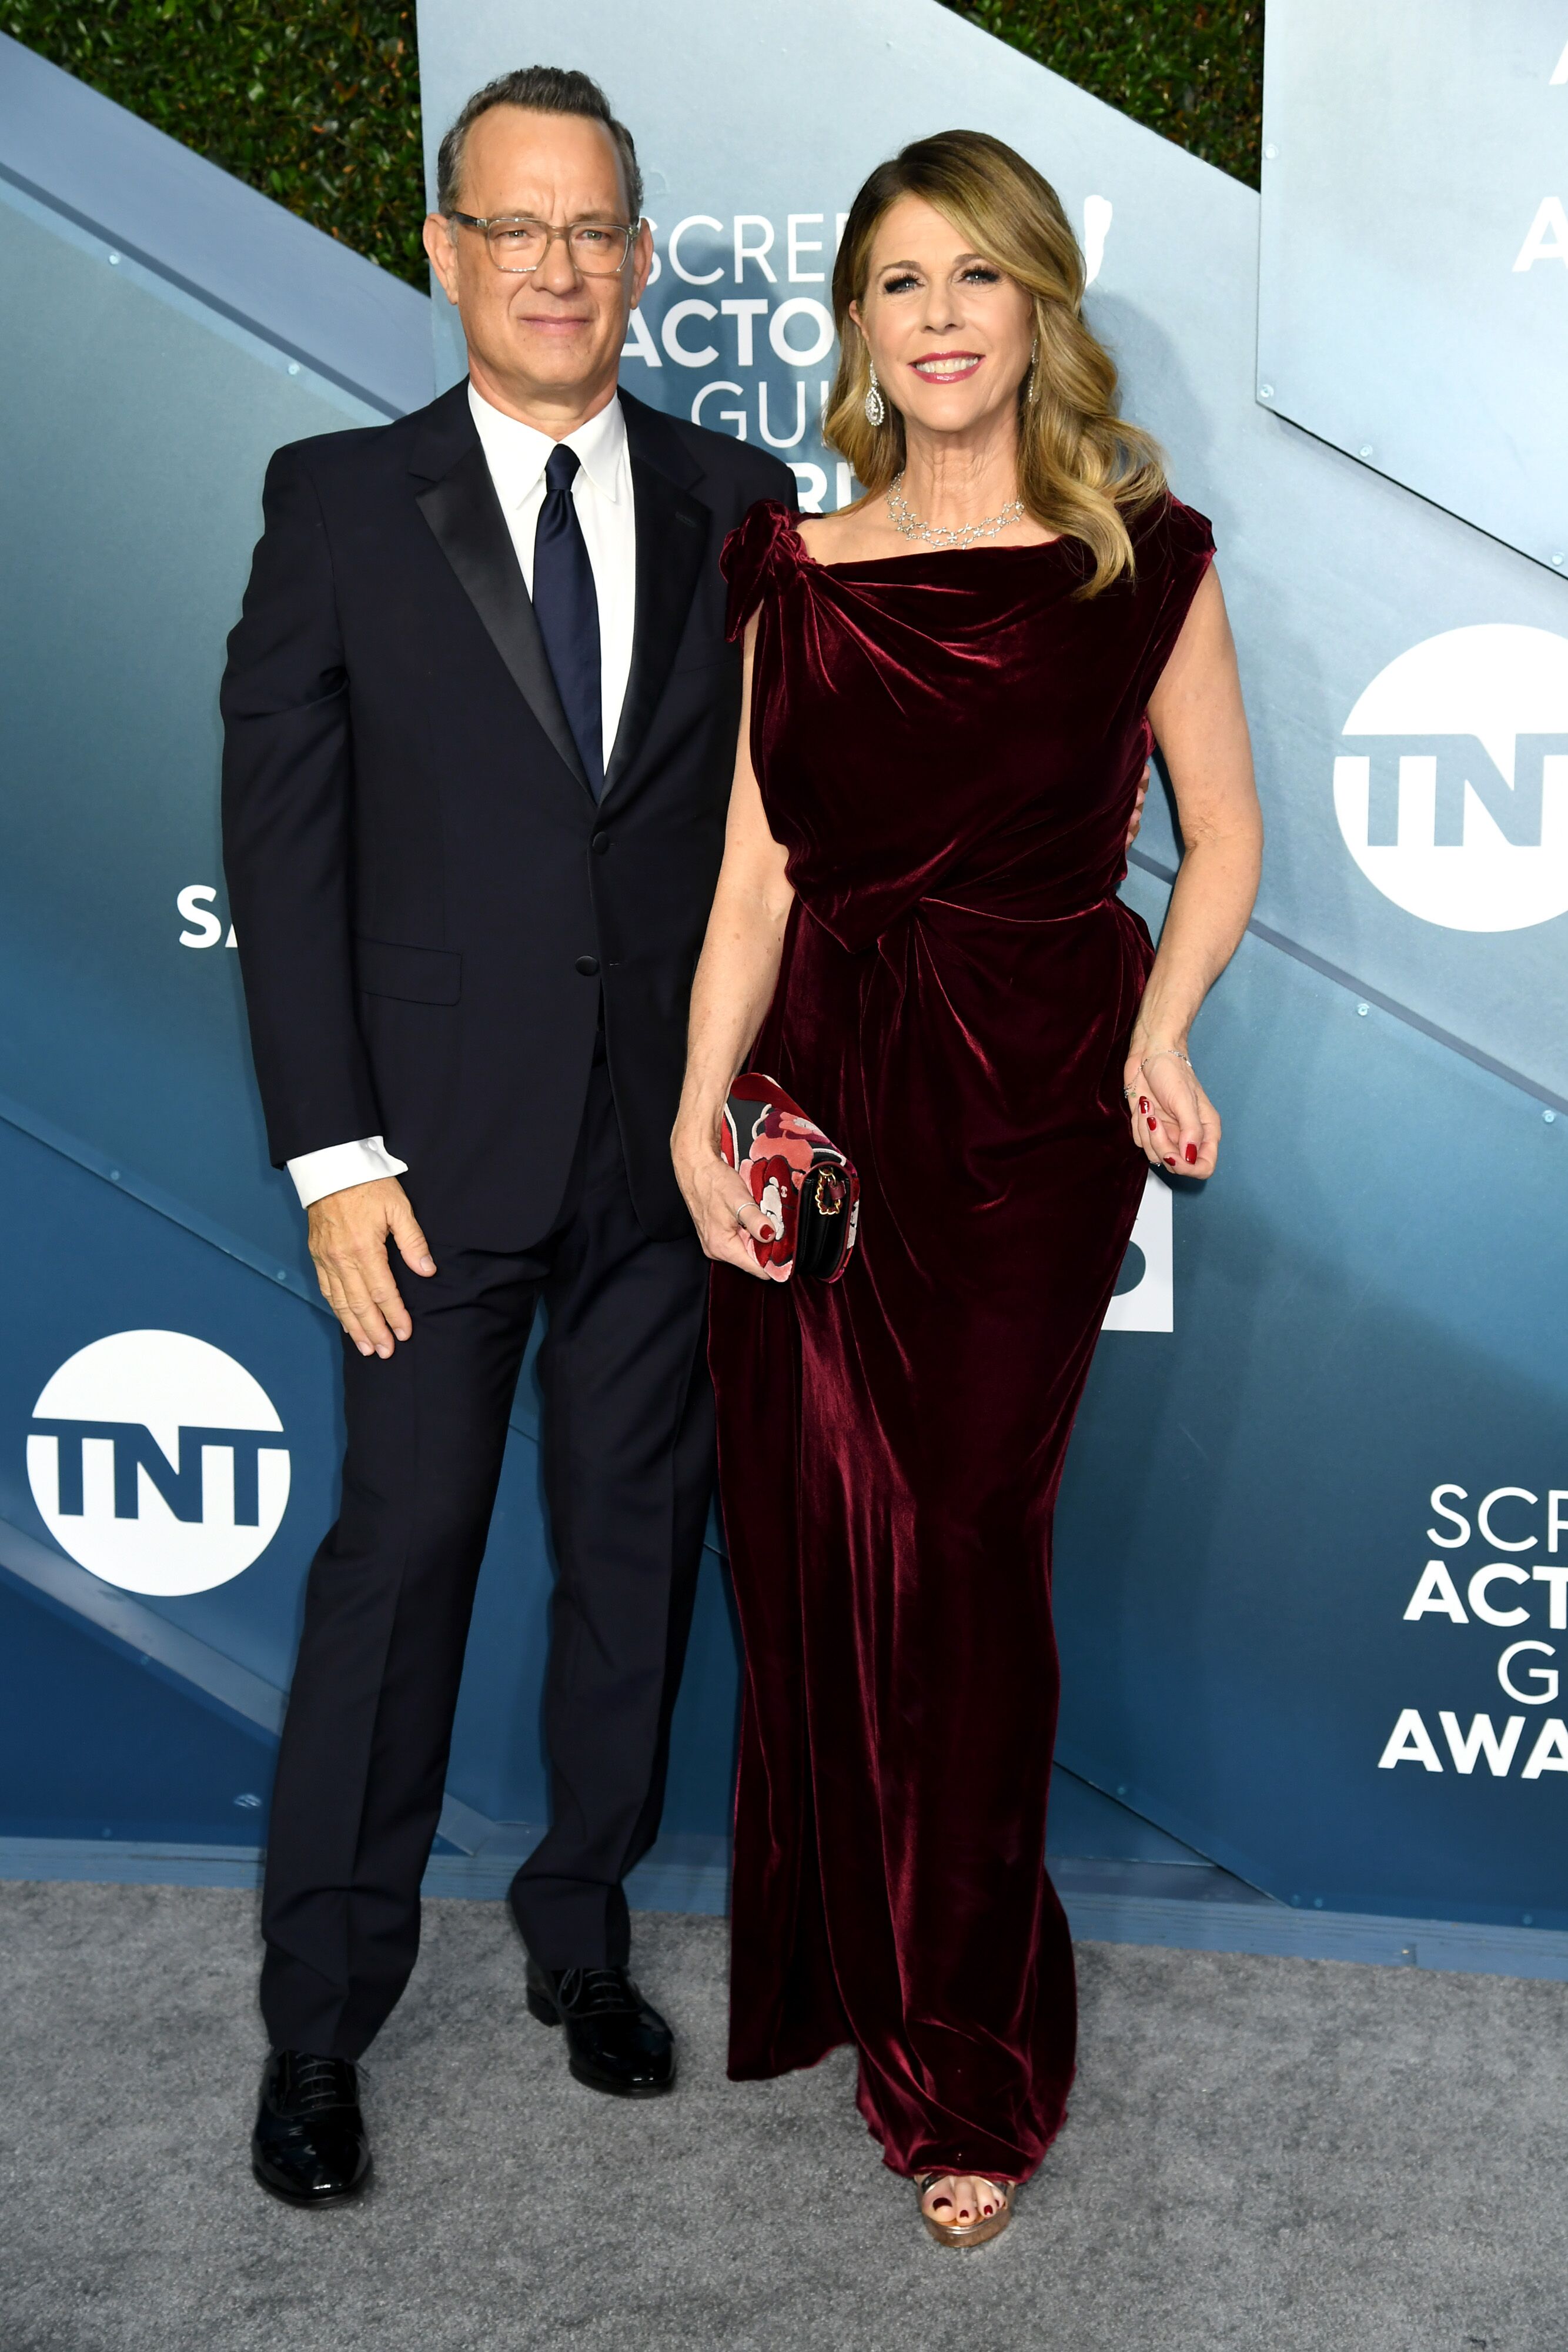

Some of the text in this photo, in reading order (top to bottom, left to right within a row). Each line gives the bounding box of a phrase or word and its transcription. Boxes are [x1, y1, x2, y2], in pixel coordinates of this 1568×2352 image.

[638, 213, 850, 286] CRE
[28, 1417, 289, 1527] TNT
[1403, 1560, 1568, 1629] ACT
[1497, 1640, 1559, 1705] G
[1378, 1708, 1568, 1779] AWA
